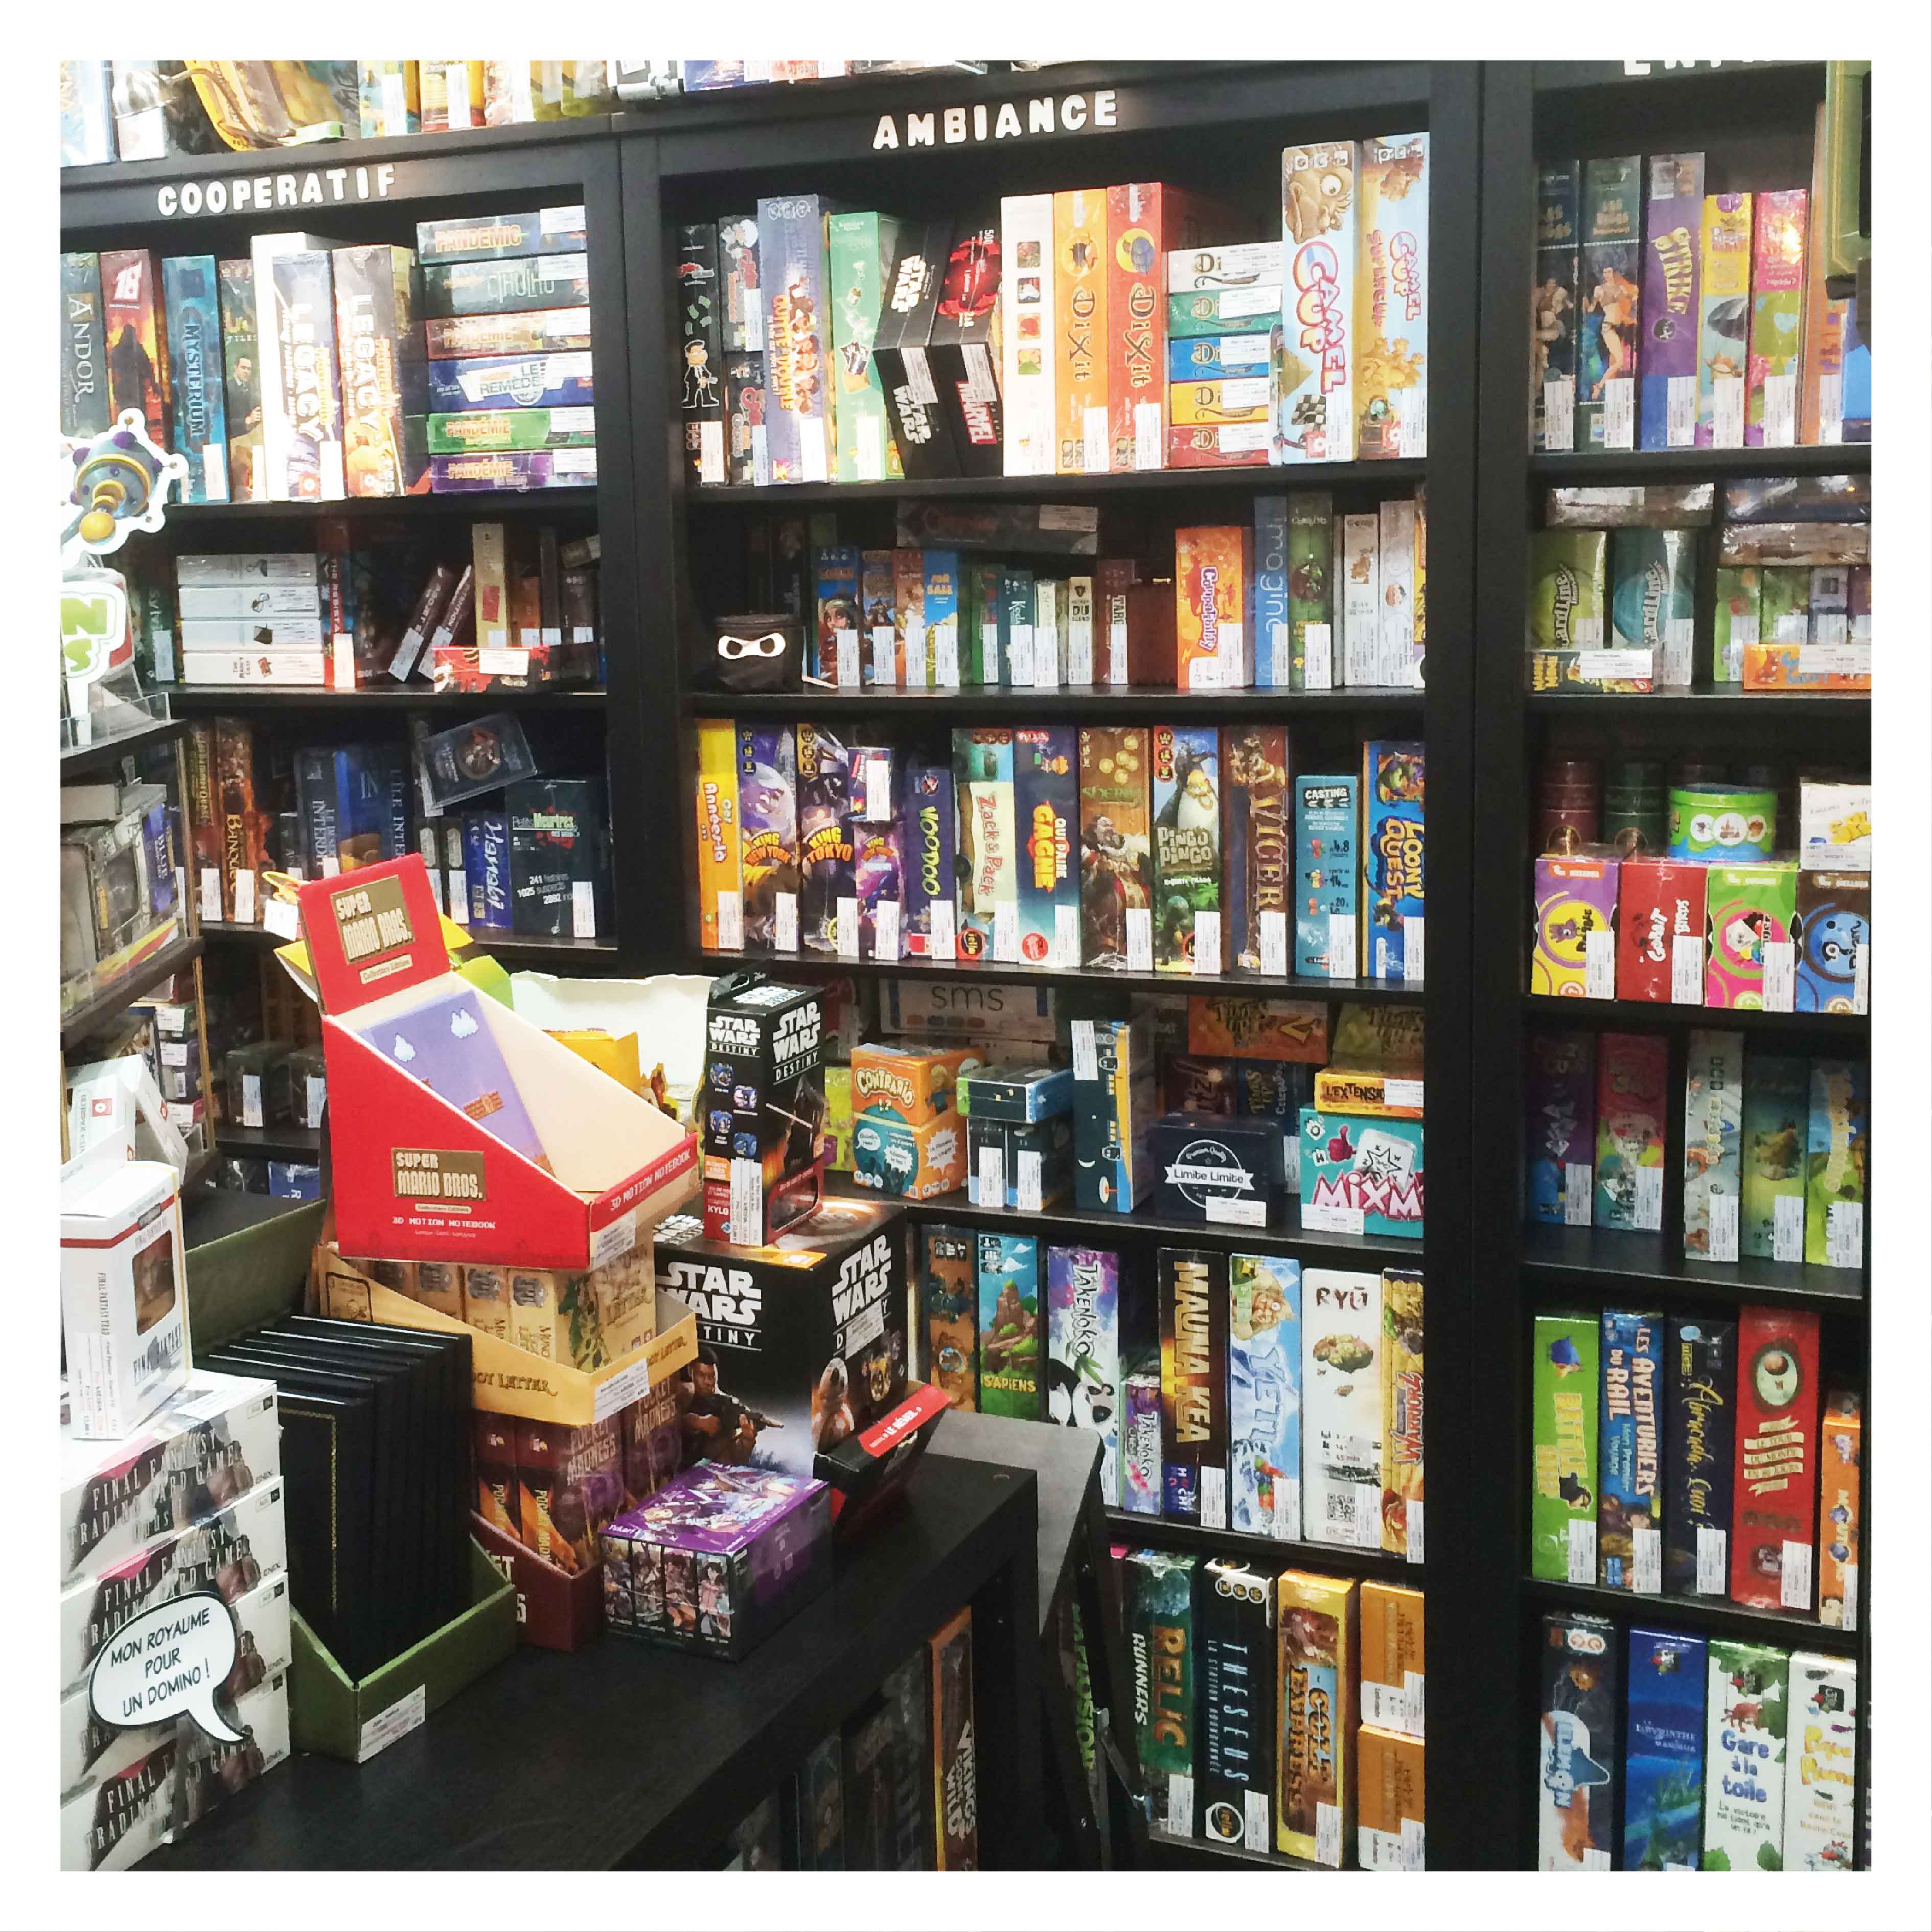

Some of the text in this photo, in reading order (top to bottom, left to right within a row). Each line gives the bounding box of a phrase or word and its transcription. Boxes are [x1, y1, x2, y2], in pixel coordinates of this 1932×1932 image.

[872, 90, 1117, 149] AMBIANCE
[158, 164, 395, 216] COOPERATIF
[891, 257, 913, 311] WARS
[905, 255, 927, 312] STAR
[1390, 231, 1422, 321] CAMEL
[1650, 227, 1692, 315] STRIKE
[1293, 241, 1346, 394] CAMEL
[67, 294, 94, 403] ANDOR
[291, 303, 324, 442] LEGACY
[352, 294, 382, 430] LEGACY
[520, 362, 537, 377] LE
[183, 324, 206, 436] MYSTERIUM
[893, 386, 926, 444] WARS
[955, 381, 997, 444] MARVEL
[332, 583, 340, 633] RESISTA
[1305, 788, 1348, 800] CASTING
[393, 816, 405, 857] INTE
[752, 832, 780, 847] KING
[806, 842, 854, 864] TOKYO
[809, 827, 842, 849] KING
[919, 806, 941, 895] VOODOO
[977, 794, 1003, 895] Zack Pack
[1032, 804, 1056, 889] GAGNE
[1054, 817, 1068, 879] QUI PAIRE
[1250, 794, 1287, 928] VICER
[1380, 818, 1404, 900] QUEST
[1402, 820, 1425, 899] LOONY
[484, 820, 506, 910] Hanabi
[336, 890, 372, 921] SUPER
[342, 907, 413, 960] MARIO BROS.
[714, 1015, 761, 1032] STAR
[772, 1001, 821, 1039] STAR
[932, 985, 1004, 1012] sms
[709, 1029, 761, 1047] WARS
[711, 1043, 758, 1056] DESTINY
[772, 1022, 821, 1064] WARS
[775, 1051, 819, 1080] DESTINY
[856, 1068, 914, 1108] CONTRARIO
[1327, 1083, 1385, 1101] L'EXTENSIO
[395, 1151, 439, 1170] SUPER
[397, 1170, 484, 1199] MARIO BROS.
[610, 1148, 691, 1211] 3D MOTION NOTEBOOK
[1174, 1168, 1244, 1184] Limite Limite
[707, 1204, 729, 1216] KYLO
[1313, 1170, 1424, 1221] MiXM
[392, 1216, 496, 1230] 3D MOTION NOTEBOOK
[655, 1261, 762, 1299] STAR
[832, 1234, 892, 1297] STAR
[832, 1261, 892, 1326] WARS
[1073, 1260, 1101, 1359] TAKENOKO
[703, 1326, 755, 1346] TINY
[1174, 1261, 1211, 1444] MAUNA KEA
[498, 1373, 558, 1396] LETTER
[982, 1375, 1037, 1393] SAPIENS
[1249, 1346, 1284, 1444] YETI
[1606, 1348, 1631, 1421] DU RAIL
[634, 1395, 677, 1443] MADNESS
[1631, 1327, 1657, 1497] LES AVENTURIERS
[196, 1444, 235, 1485] GAME
[567, 1433, 617, 1482] MADNESS
[1136, 1411, 1158, 1478] TAKENOKO
[93, 1466, 141, 1511] FINAL
[534, 1489, 553, 1563] POCKET MADN
[205, 1540, 242, 1581] GAME
[103, 1565, 152, 1612] FINAL
[110, 1607, 211, 1668] MON ROYAUME
[145, 1647, 182, 1679] POUR
[122, 1658, 211, 1718] UN DOMINO !
[1132, 1633, 1149, 1726] RUNNERS
[1152, 1625, 1187, 1748] RELIC
[1222, 1642, 1250, 1782] THESEUS
[1720, 1729, 1770, 1759] Gare
[1731, 1756, 1758, 1776] à la
[107, 1768, 155, 1814] FINAL
[945, 1765, 965, 1841] WILD
[956, 1719, 976, 1836] VIKINGS
[1721, 1775, 1767, 1803] toile
